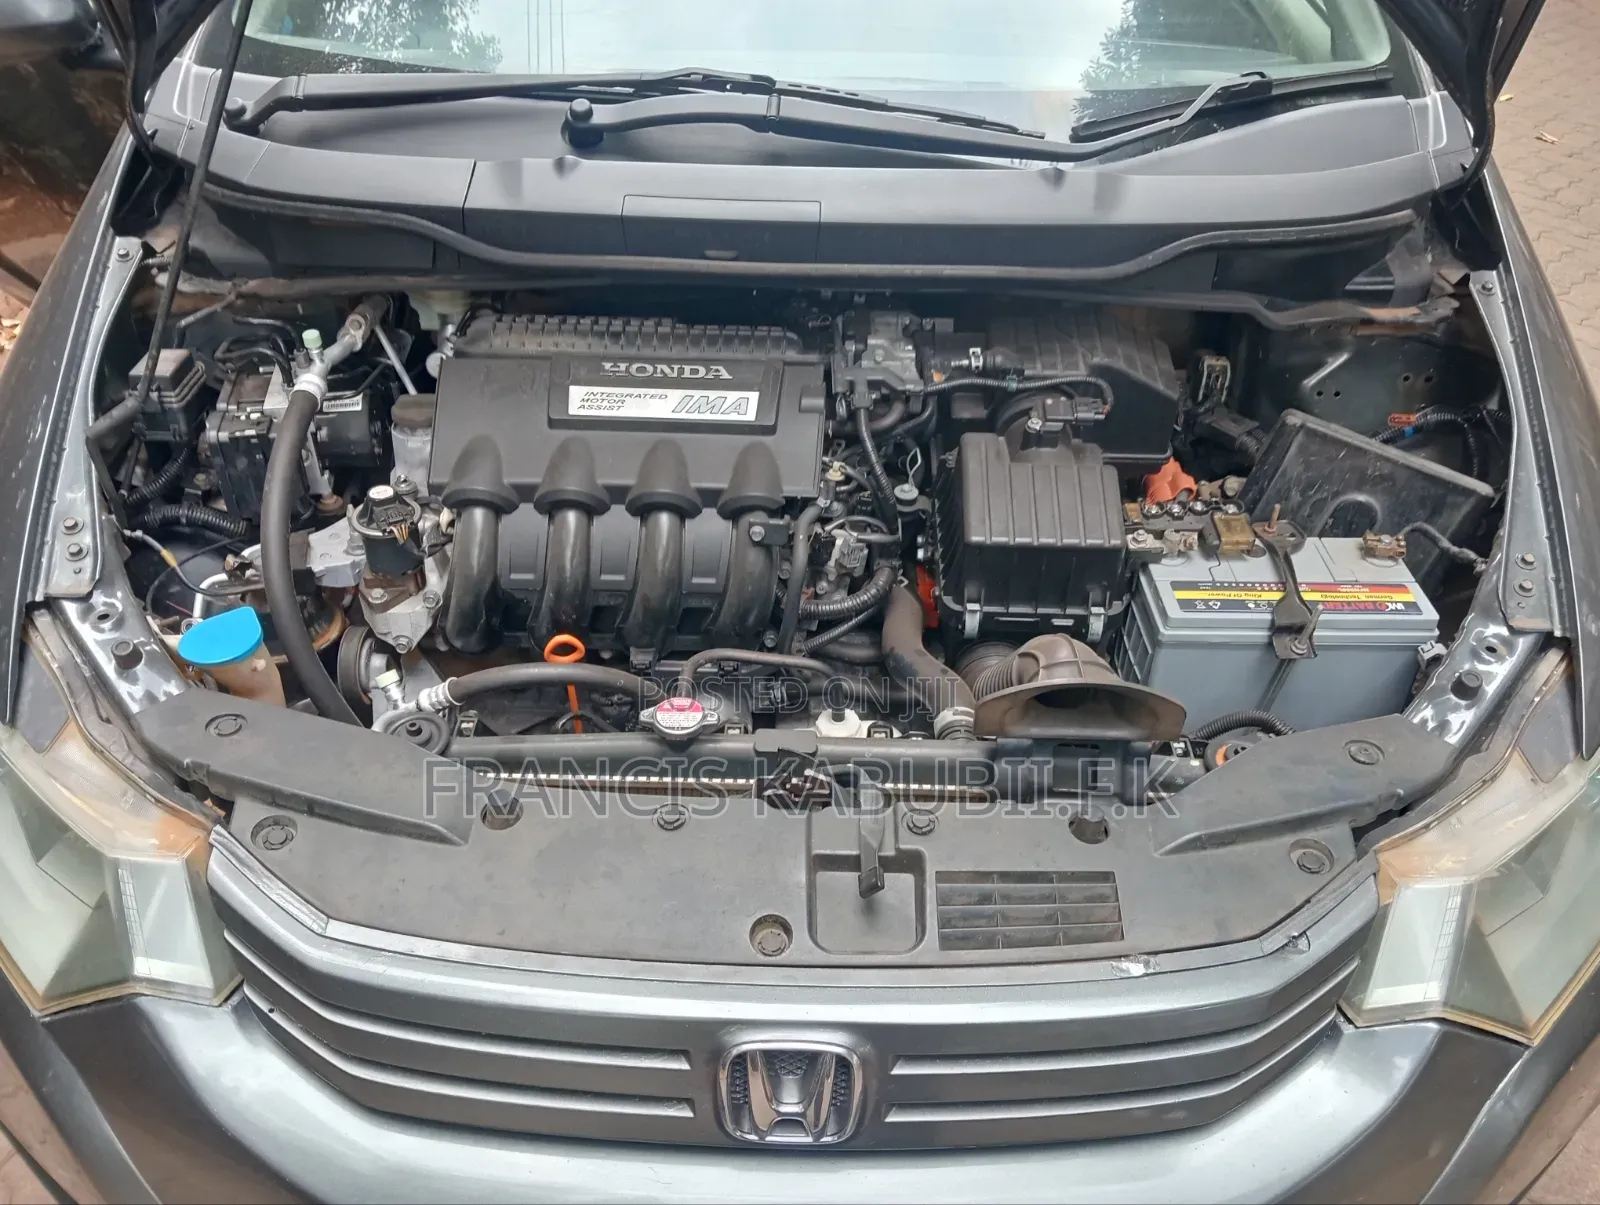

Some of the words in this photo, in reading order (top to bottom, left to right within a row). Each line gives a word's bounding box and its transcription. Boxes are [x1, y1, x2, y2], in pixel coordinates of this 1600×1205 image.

[600, 361, 733, 380] HONDA
[583, 391, 668, 400] INTEGRATED
[576, 404, 624, 412] ASSIST
[672, 394, 750, 415] IMA
[1319, 601, 1374, 611] BATTER
